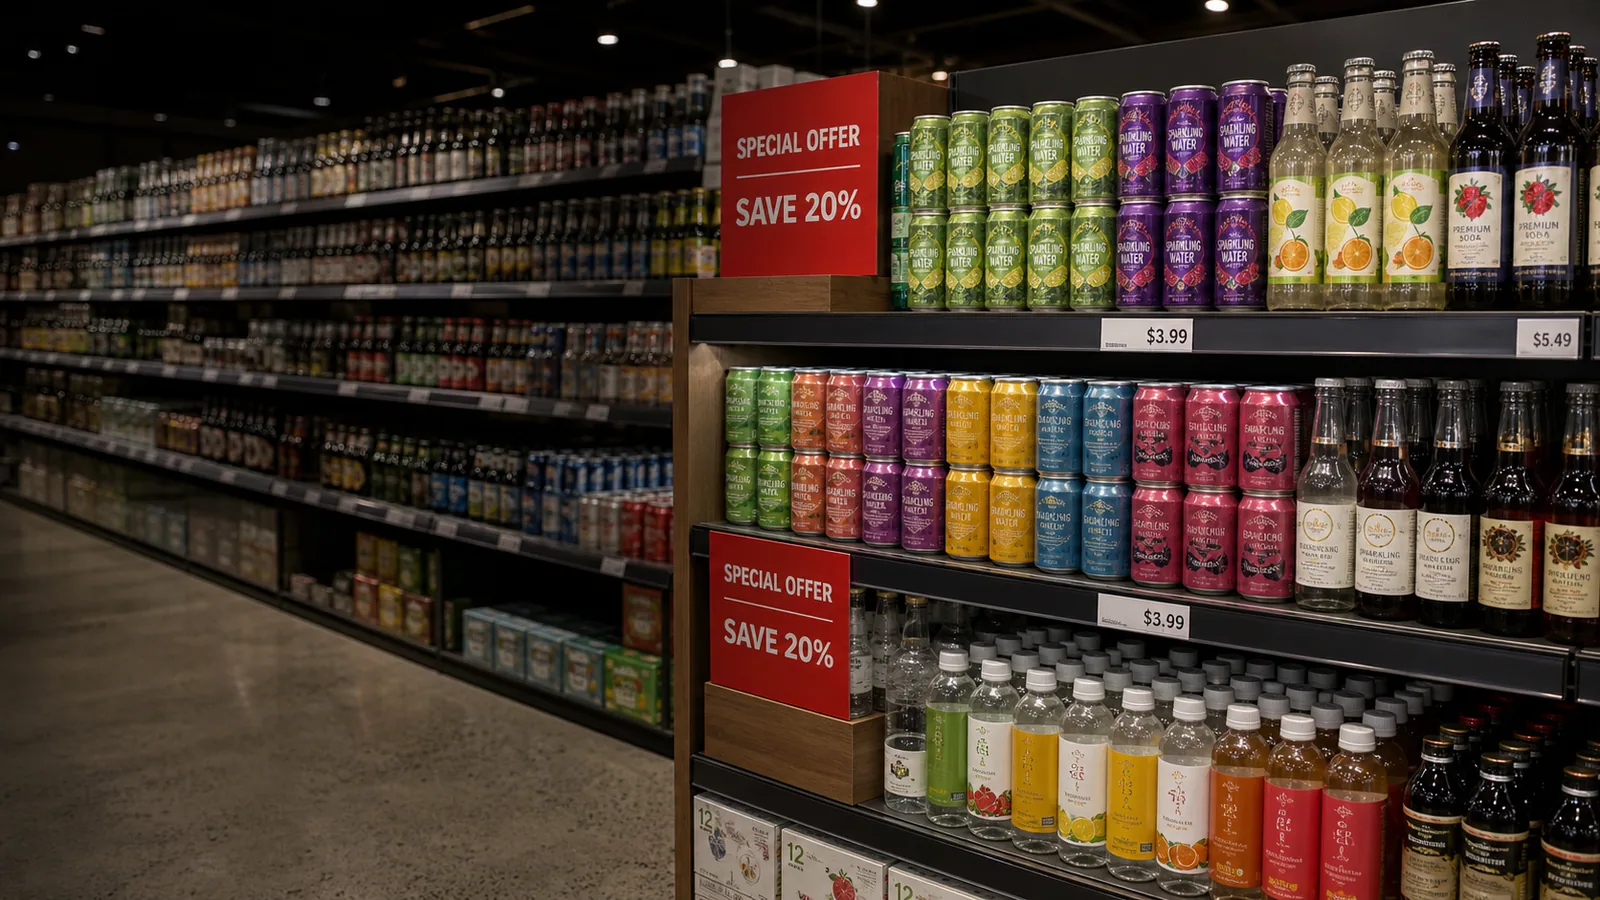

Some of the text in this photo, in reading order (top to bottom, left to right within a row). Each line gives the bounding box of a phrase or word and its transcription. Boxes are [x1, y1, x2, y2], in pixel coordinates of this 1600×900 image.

[737, 124, 861, 160] SPECIAL OFFER
[1122, 142, 1146, 155] WATER
[1171, 138, 1197, 151] WATER
[1224, 135, 1250, 147] WATER
[735, 188, 862, 228] SAVE 20%
[1033, 255, 1057, 265] WATER
[1121, 252, 1144, 264] WATER
[1169, 251, 1195, 264] WATER
[1221, 250, 1248, 262] WATER
[1146, 327, 1188, 345] $3.99
[1533, 331, 1572, 348] $5.49
[724, 563, 833, 604] SPECIAL OFFER
[1143, 608, 1184, 630] $3.99
[724, 617, 834, 669] SAVE 20%
[698, 807, 713, 830] 12
[787, 841, 805, 866] 12
[894, 882, 914, 900] 12
